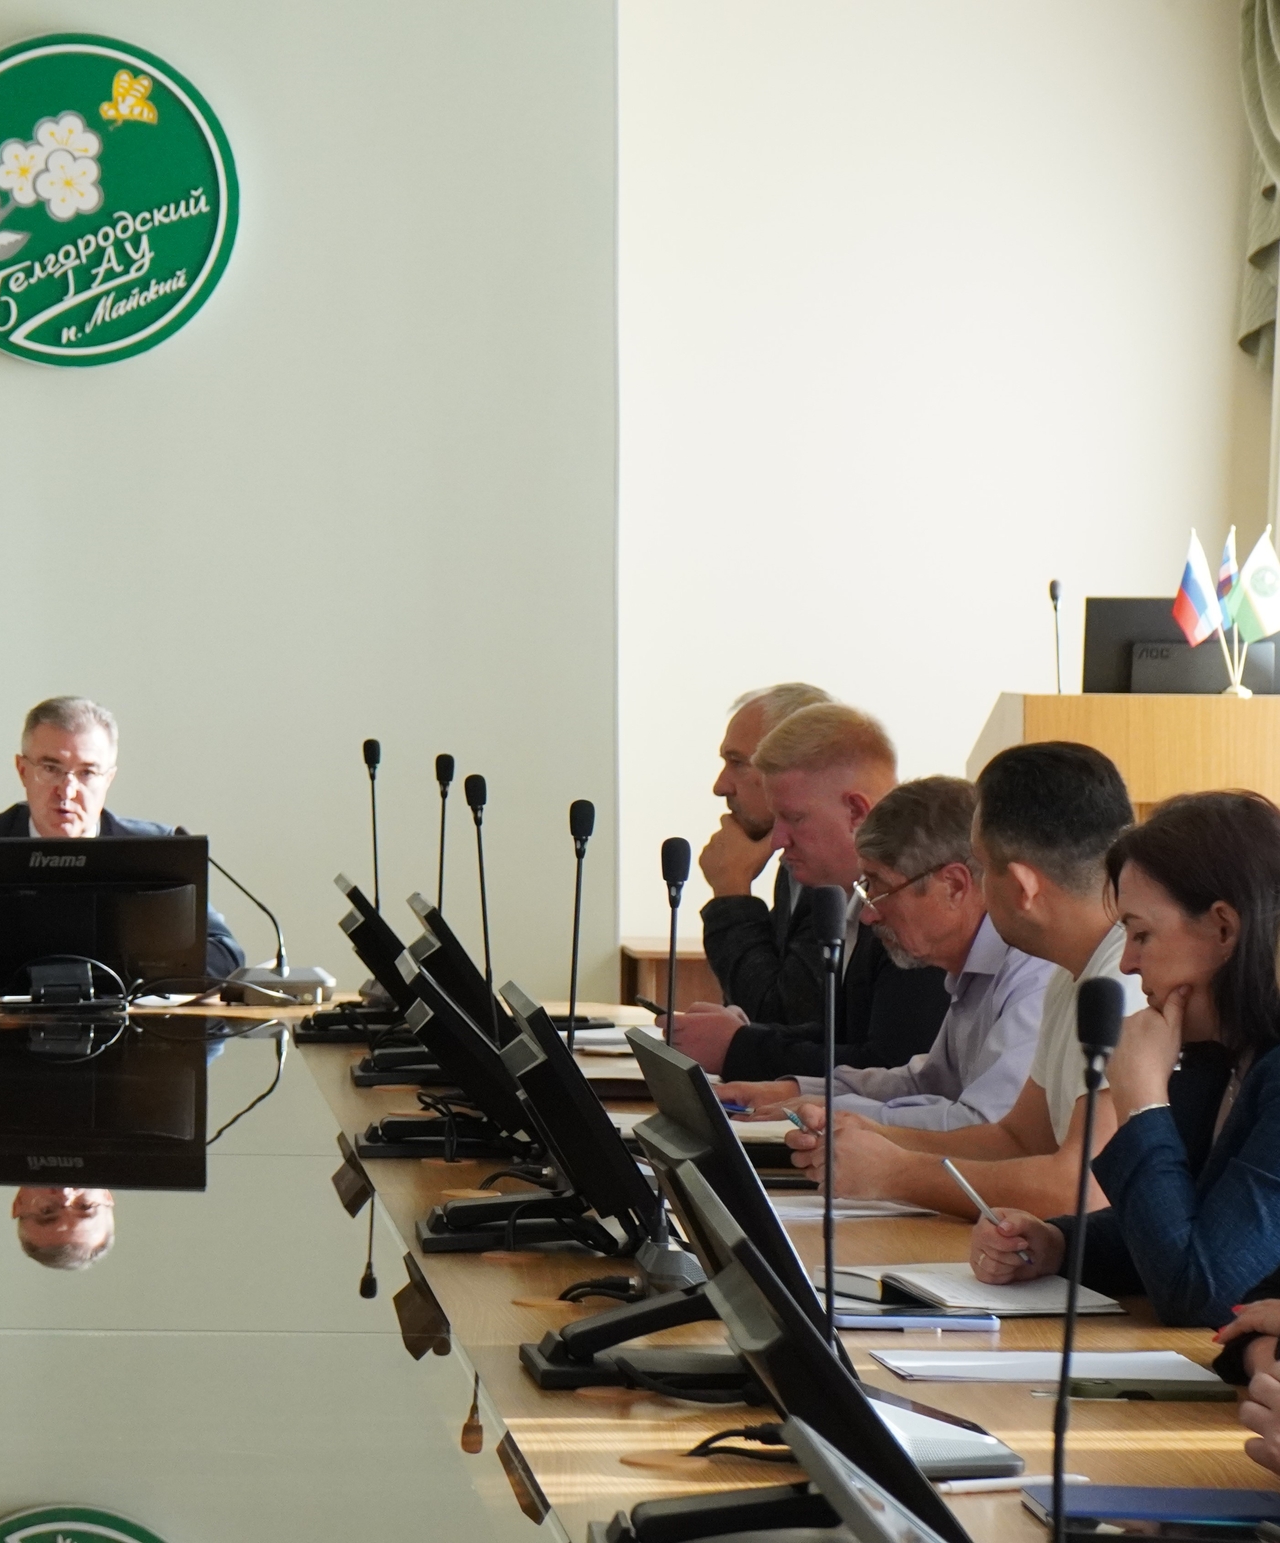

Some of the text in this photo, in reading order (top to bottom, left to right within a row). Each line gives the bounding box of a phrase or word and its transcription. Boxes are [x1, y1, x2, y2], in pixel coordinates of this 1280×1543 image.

[53, 234, 154, 303] ГАУ
[84, 267, 187, 334] Майский
[29, 851, 87, 868] iiyama
